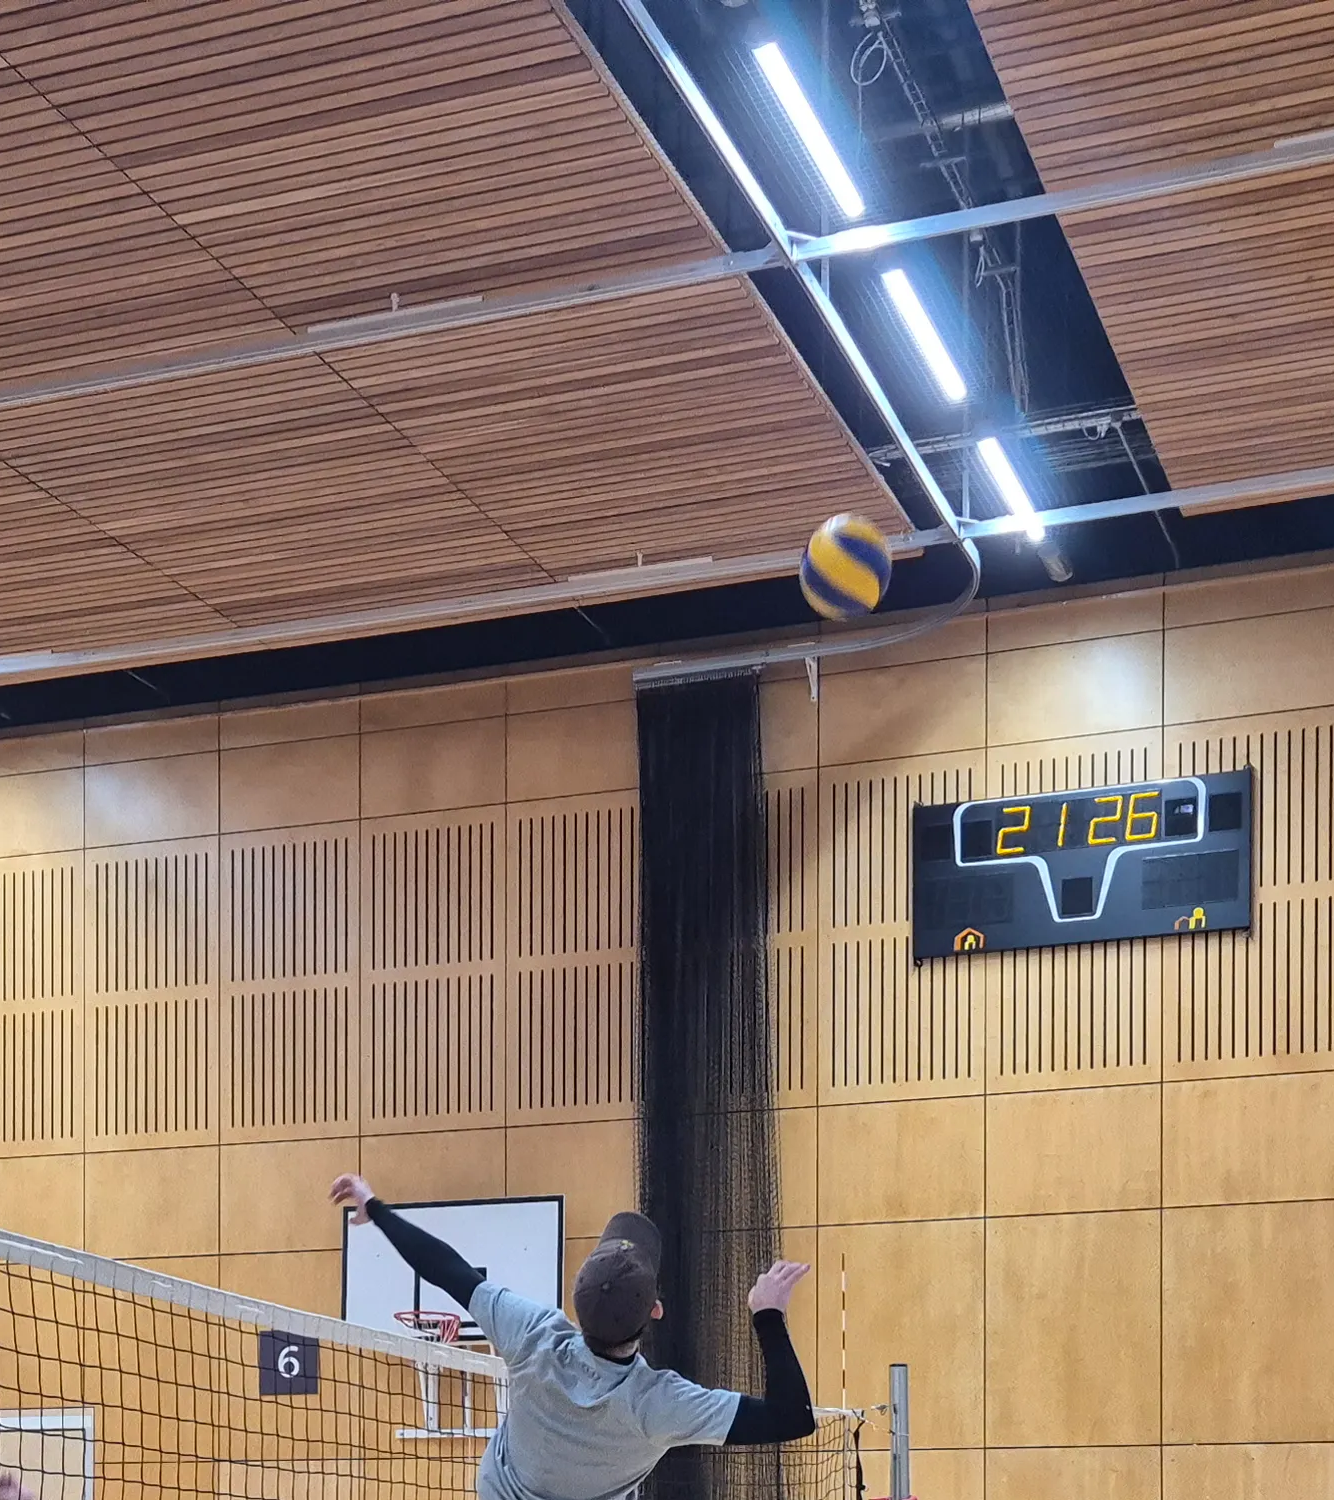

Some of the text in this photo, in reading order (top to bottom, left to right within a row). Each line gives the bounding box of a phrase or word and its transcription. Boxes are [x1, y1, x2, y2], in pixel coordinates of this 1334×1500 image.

[996, 790, 1161, 856] 21 26
[278, 1345, 300, 1378] 6
